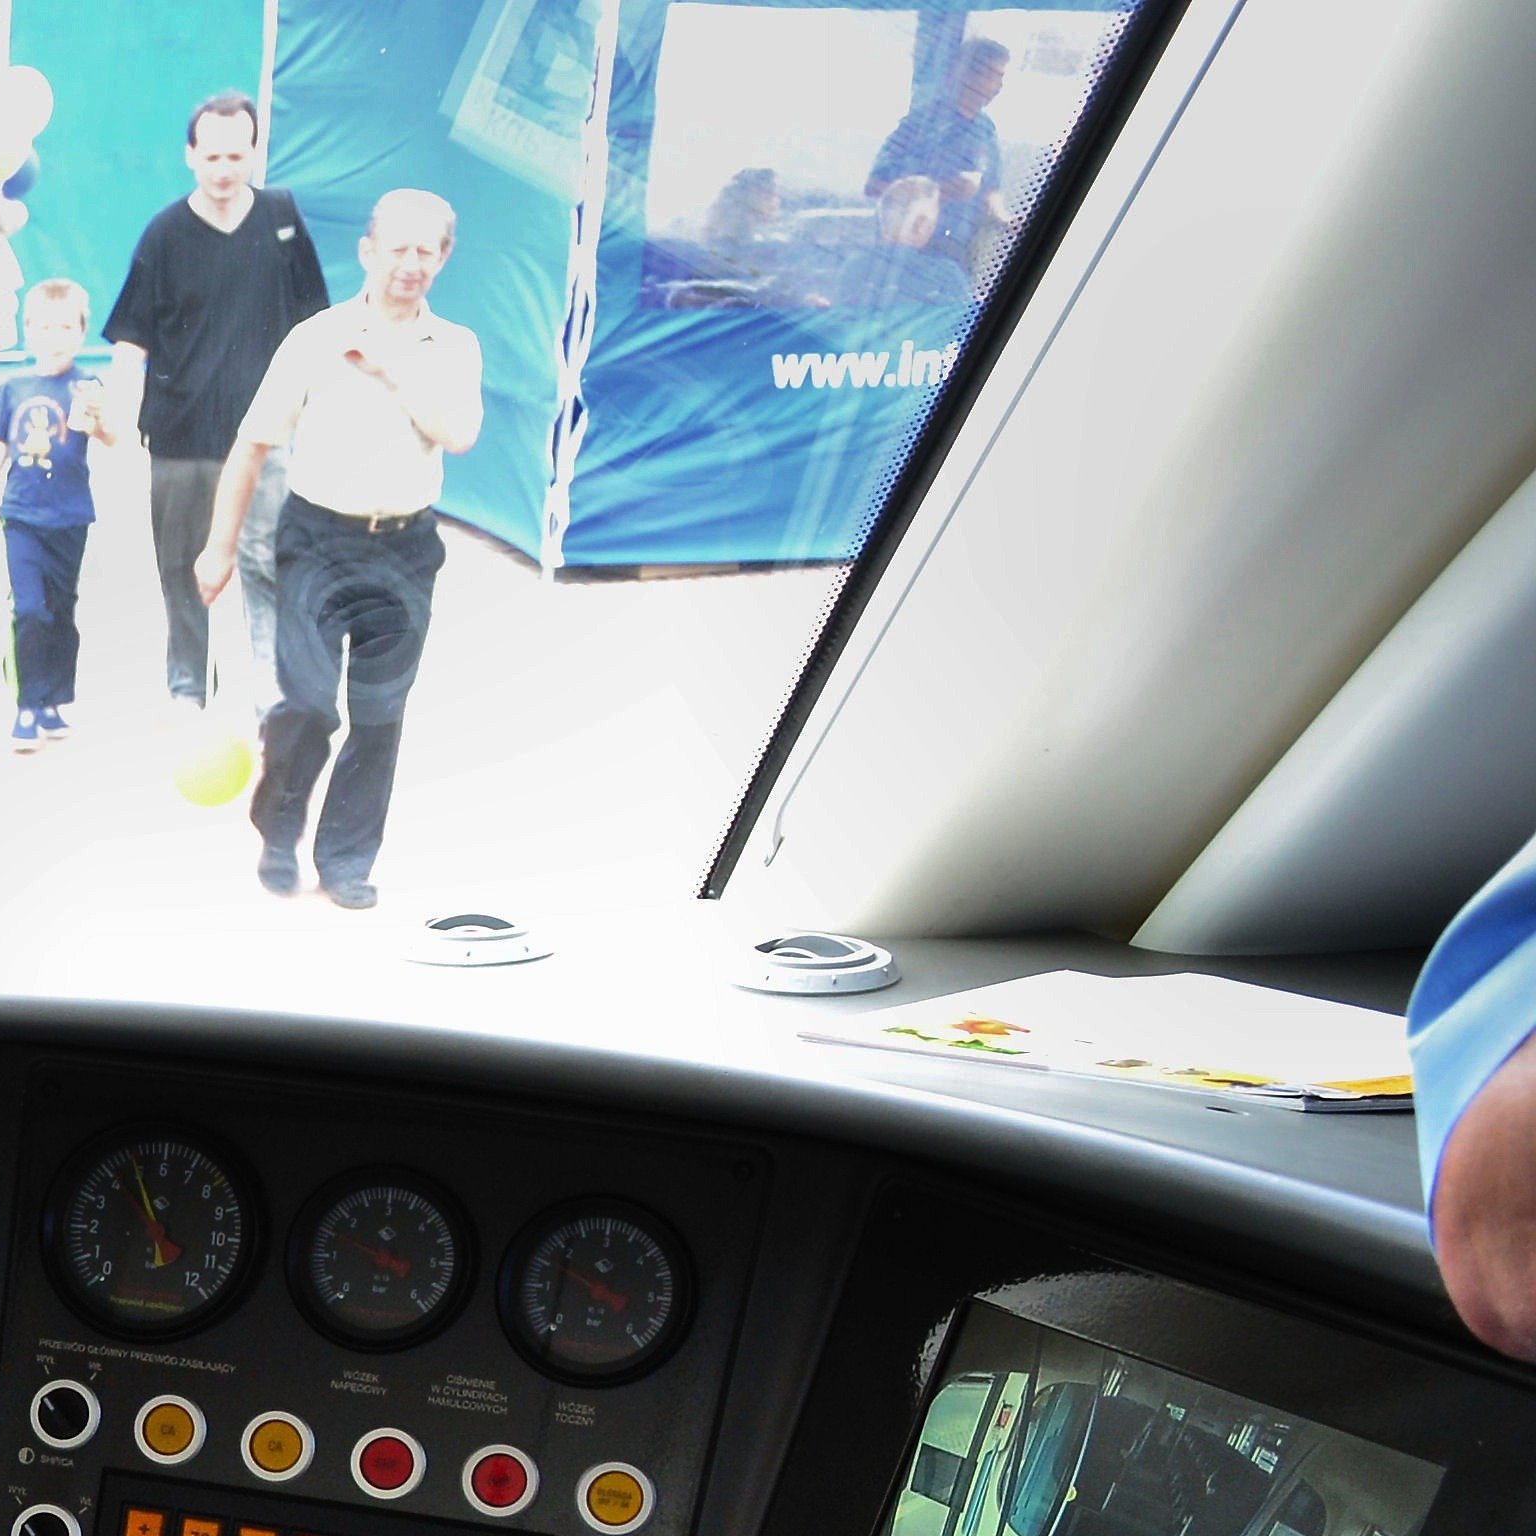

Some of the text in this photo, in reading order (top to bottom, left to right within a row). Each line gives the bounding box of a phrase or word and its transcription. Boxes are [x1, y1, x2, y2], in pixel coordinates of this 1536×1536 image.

[97, 1195, 106, 1209] 3
[214, 1206, 224, 1221] 9
[90, 1219, 100, 1234] 2
[211, 1232, 226, 1247] 10
[102, 1260, 112, 1275] 0
[205, 1254, 216, 1269] 11
[185, 1271, 200, 1286] 12
[343, 1369, 381, 1384] WÓZEK
[441, 1385, 509, 1403] CYLINDRACH
[428, 1396, 508, 1415] HAMULCOWYCH
[557, 1400, 596, 1416] WÓZEK
[554, 1411, 595, 1426] TOCZNY
